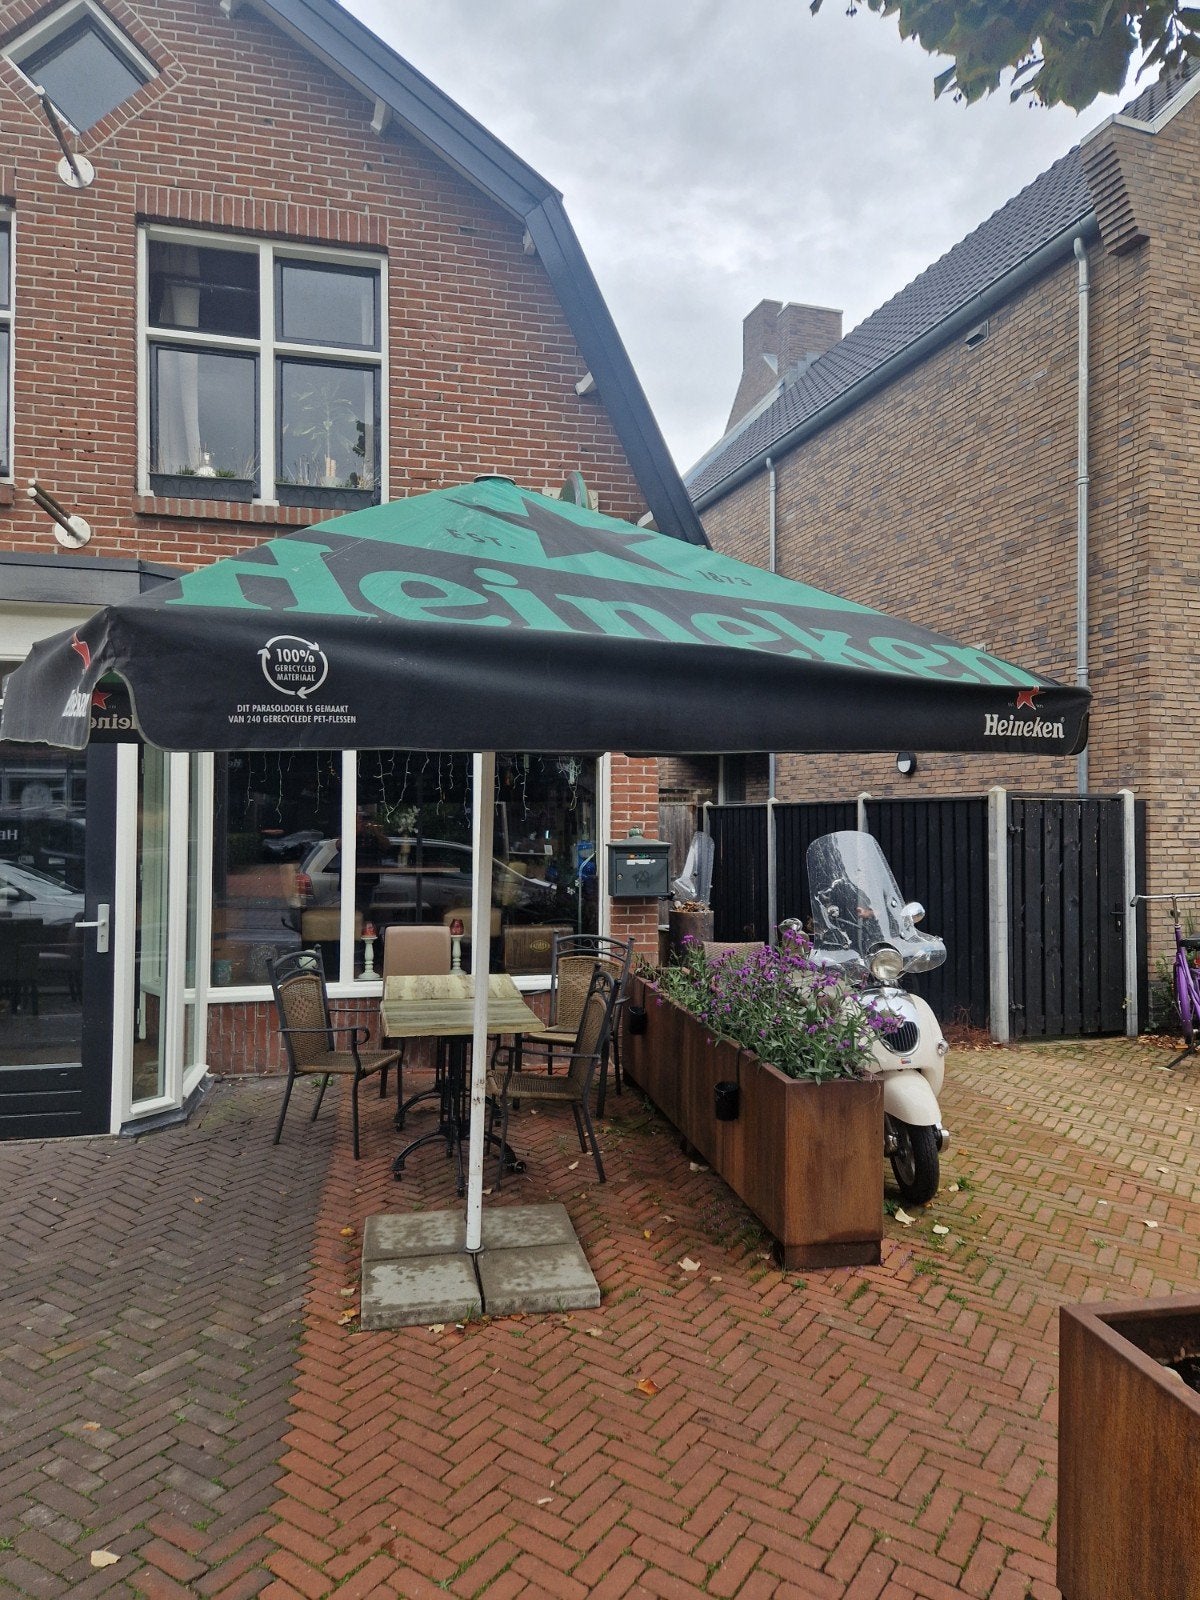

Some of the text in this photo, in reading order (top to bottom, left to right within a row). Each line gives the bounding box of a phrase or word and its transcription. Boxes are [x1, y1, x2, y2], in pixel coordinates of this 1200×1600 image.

[445, 527, 753, 586] EST. 1873
[165, 538, 1044, 687] Heineken
[276, 648, 315, 663] 100%
[275, 664, 317, 673] GERECYCLED
[276, 673, 316, 682] MATERIAAL
[237, 704, 349, 713] DIT PARASOLDOEK IS GEMAAKT
[228, 715, 357, 723] VAN 240 GERECYCLEDE PET-FLESSEN
[983, 713, 1065, 739] Heineken
